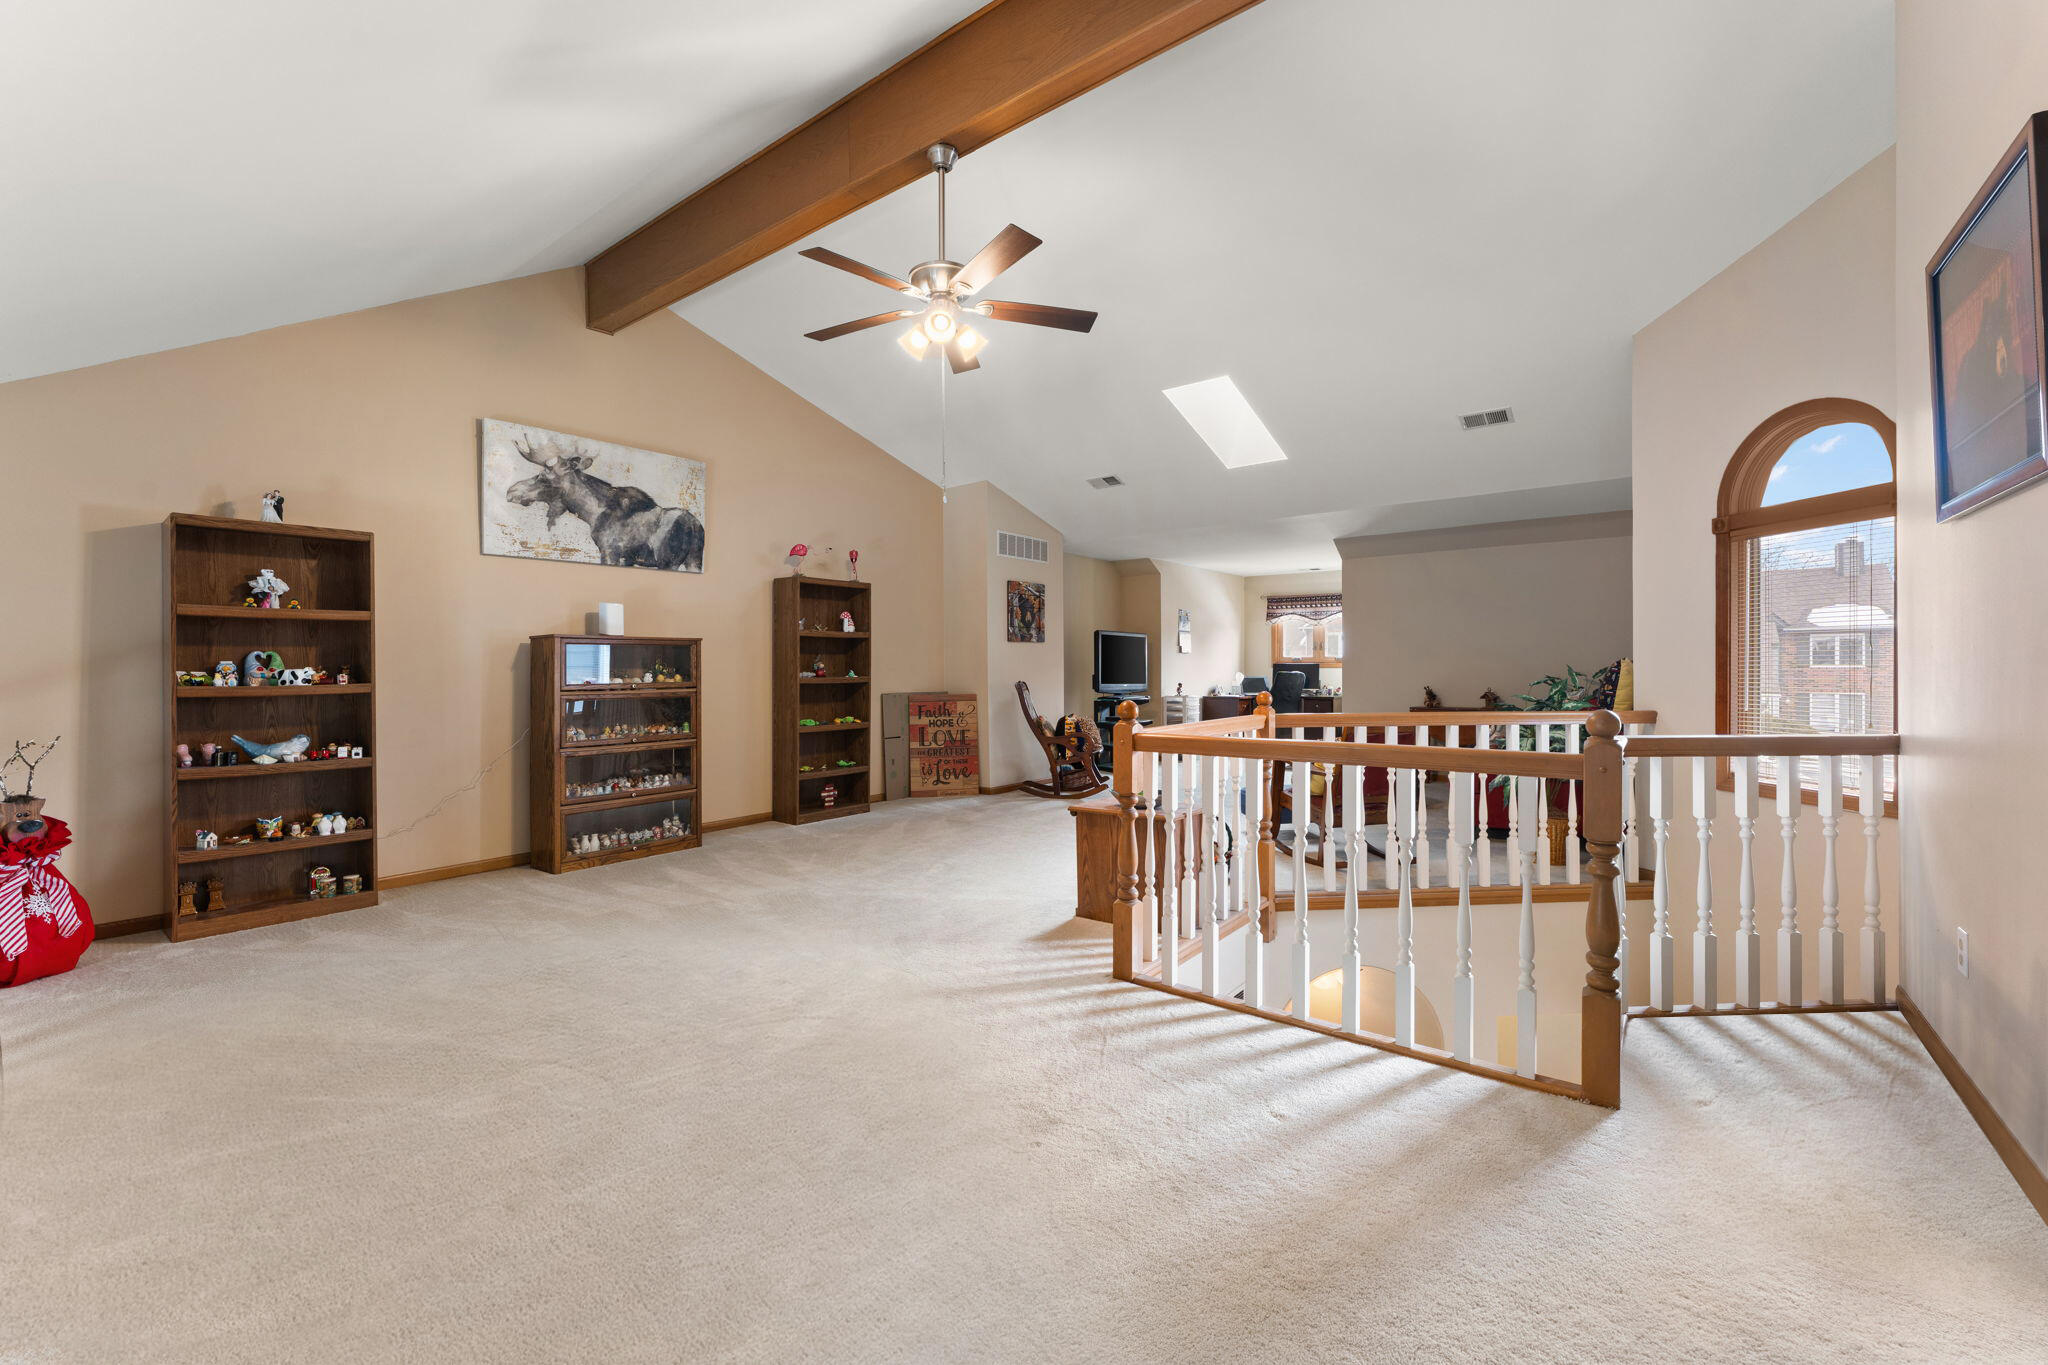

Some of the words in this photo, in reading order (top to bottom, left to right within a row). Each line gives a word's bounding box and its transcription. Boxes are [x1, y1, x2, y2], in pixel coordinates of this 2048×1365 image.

[928, 719, 954, 728] HOPE
[918, 727, 970, 747] LOVE
[932, 759, 972, 786] Love
